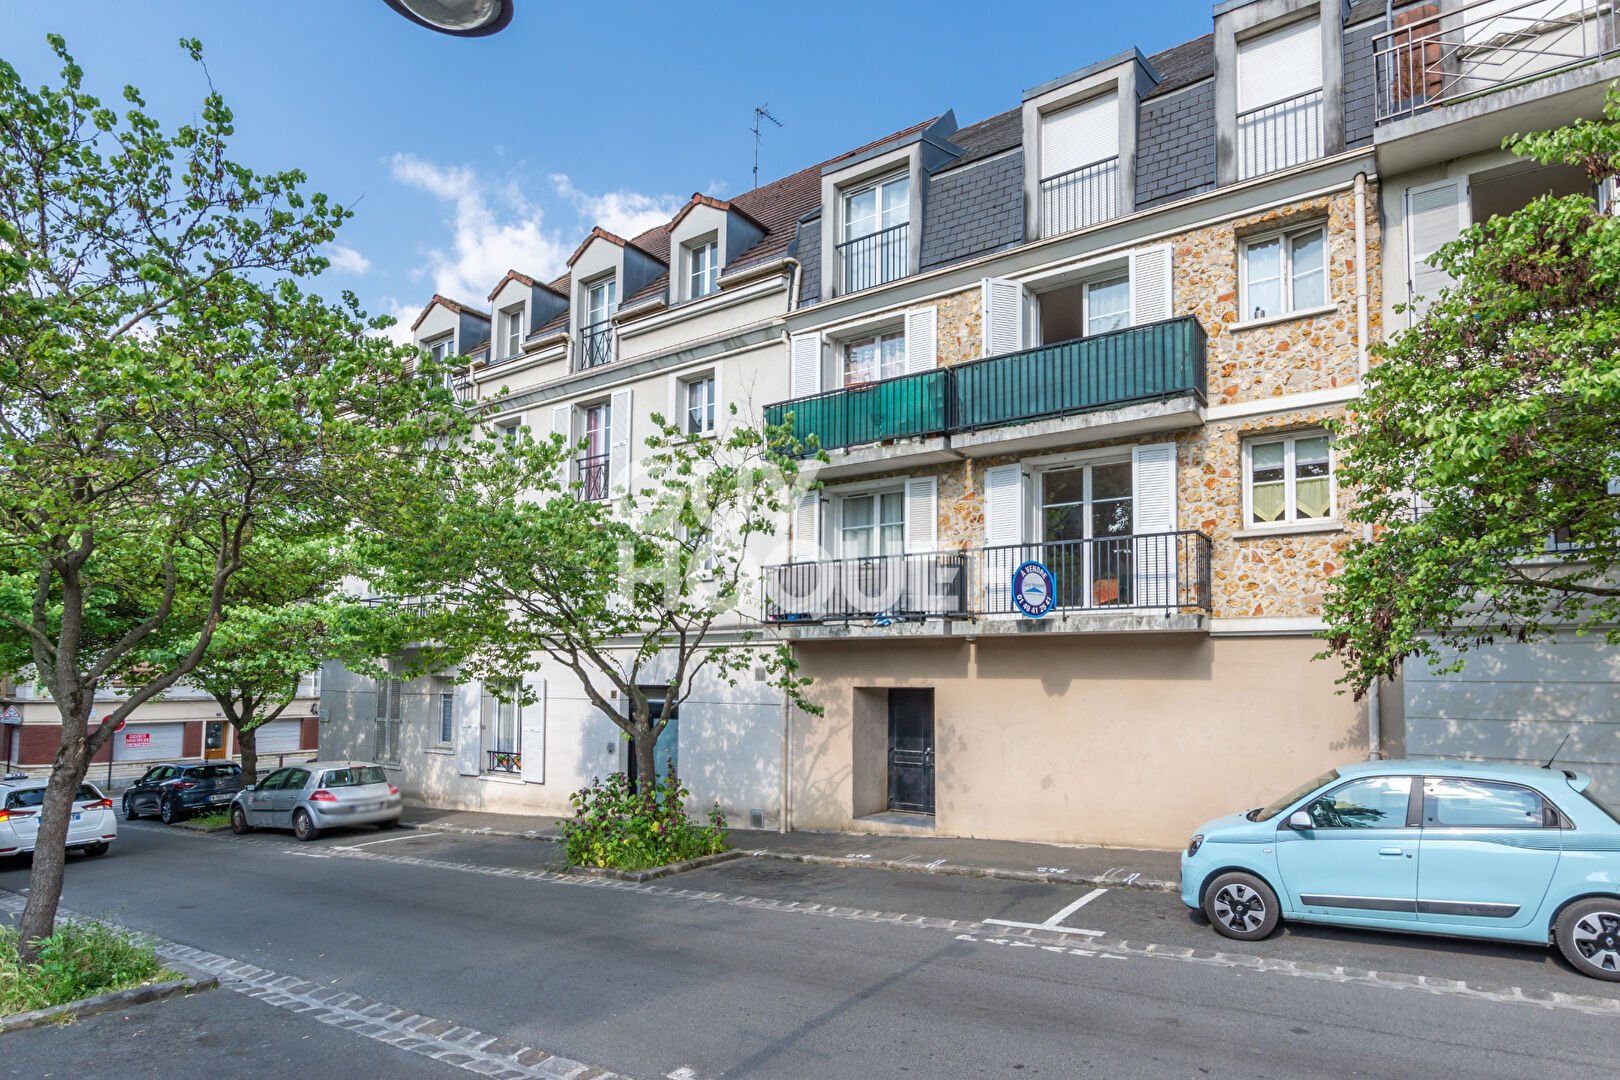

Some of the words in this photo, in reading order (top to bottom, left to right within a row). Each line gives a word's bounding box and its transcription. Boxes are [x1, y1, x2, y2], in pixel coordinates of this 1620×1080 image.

[1020, 570, 1026, 578] A
[1024, 565, 1047, 579] VENDRE
[1017, 594, 1024, 604] 01
[1023, 603, 1031, 611] 49
[1045, 596, 1051, 606] 41
